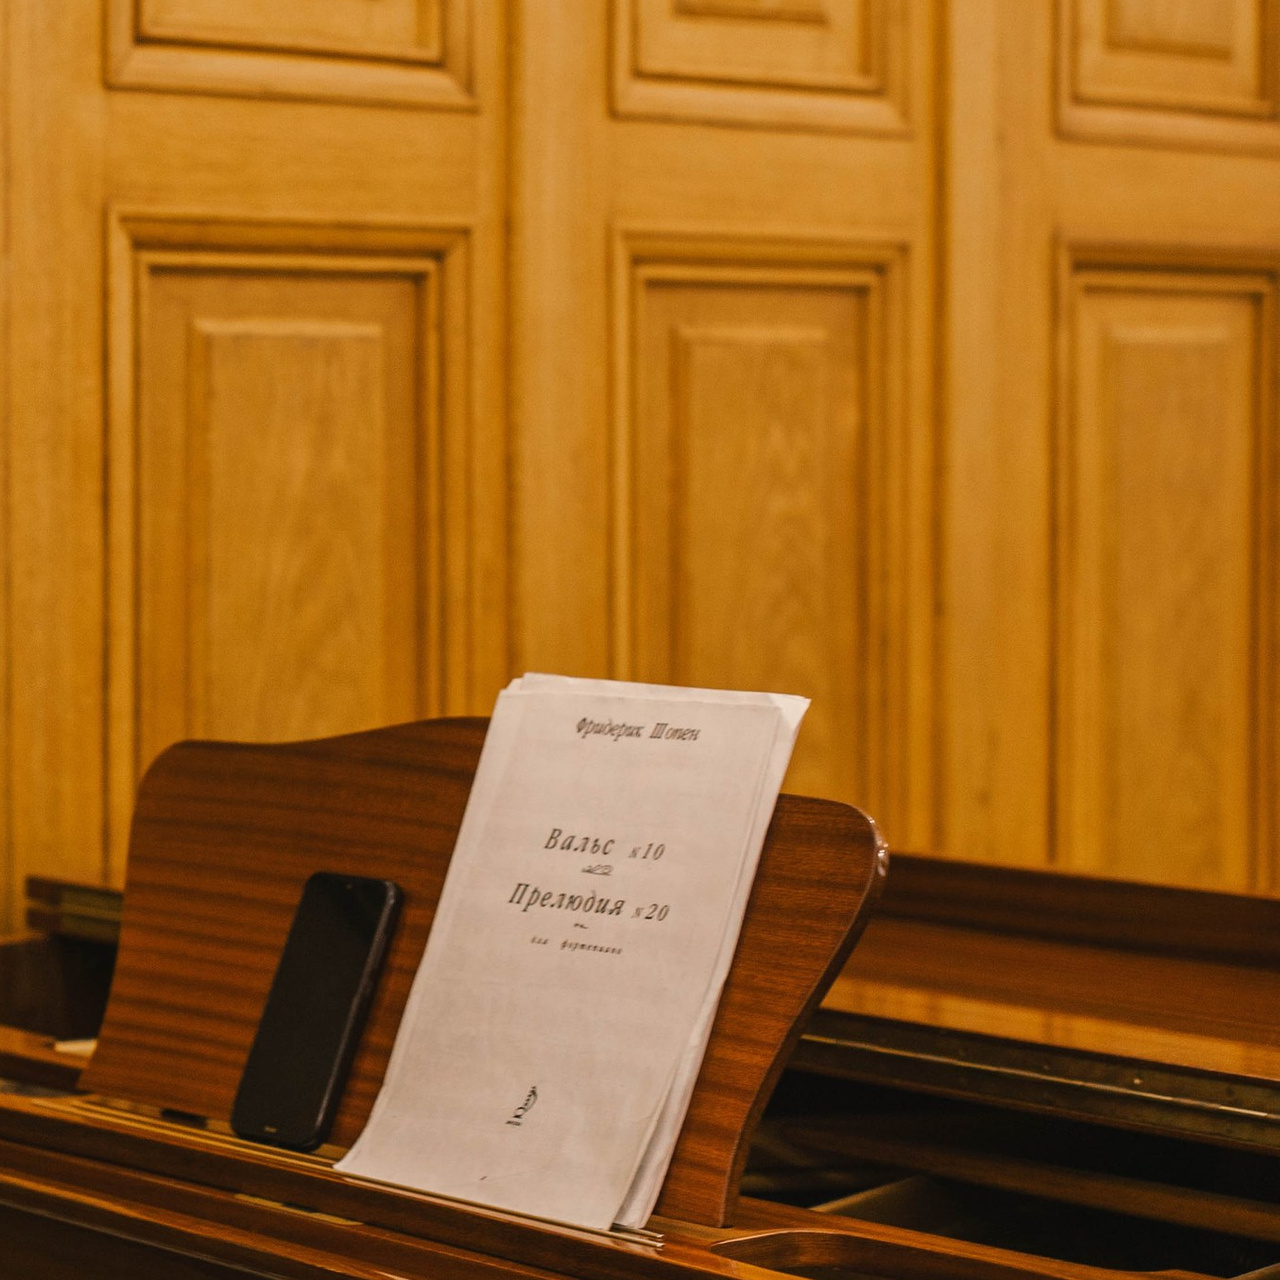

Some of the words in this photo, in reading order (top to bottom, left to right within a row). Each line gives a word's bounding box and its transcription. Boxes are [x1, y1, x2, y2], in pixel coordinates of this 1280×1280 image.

[576, 717, 645, 741] Фридерик
[650, 722, 701, 741] Шопен
[544, 827, 615, 855] Вальс
[508, 882, 625, 916] Прелюдия
